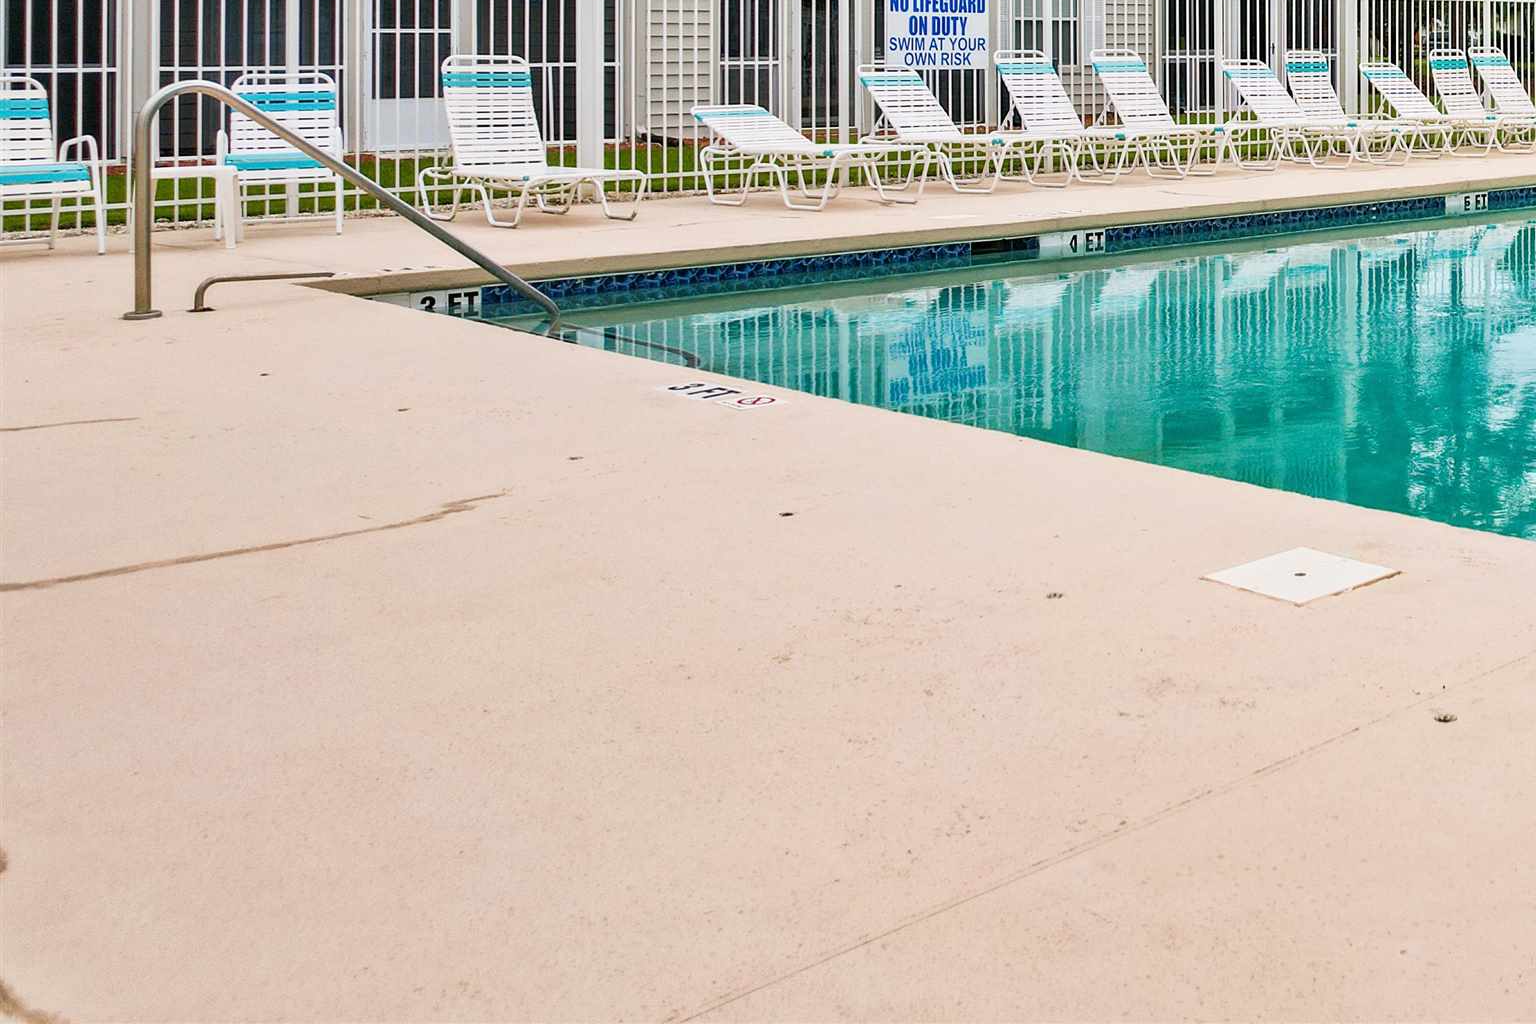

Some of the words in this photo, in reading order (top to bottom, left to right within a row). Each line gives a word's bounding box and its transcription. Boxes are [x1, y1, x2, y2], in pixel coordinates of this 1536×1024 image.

[909, 15, 928, 36] ON
[931, 16, 968, 36] DUTY
[889, 37, 925, 51] SWIM
[929, 37, 945, 51] AT
[949, 37, 986, 51] YOUR
[904, 52, 936, 66] OWN
[941, 52, 972, 66] RISK
[668, 383, 705, 391] 3
[687, 387, 742, 399] FT
